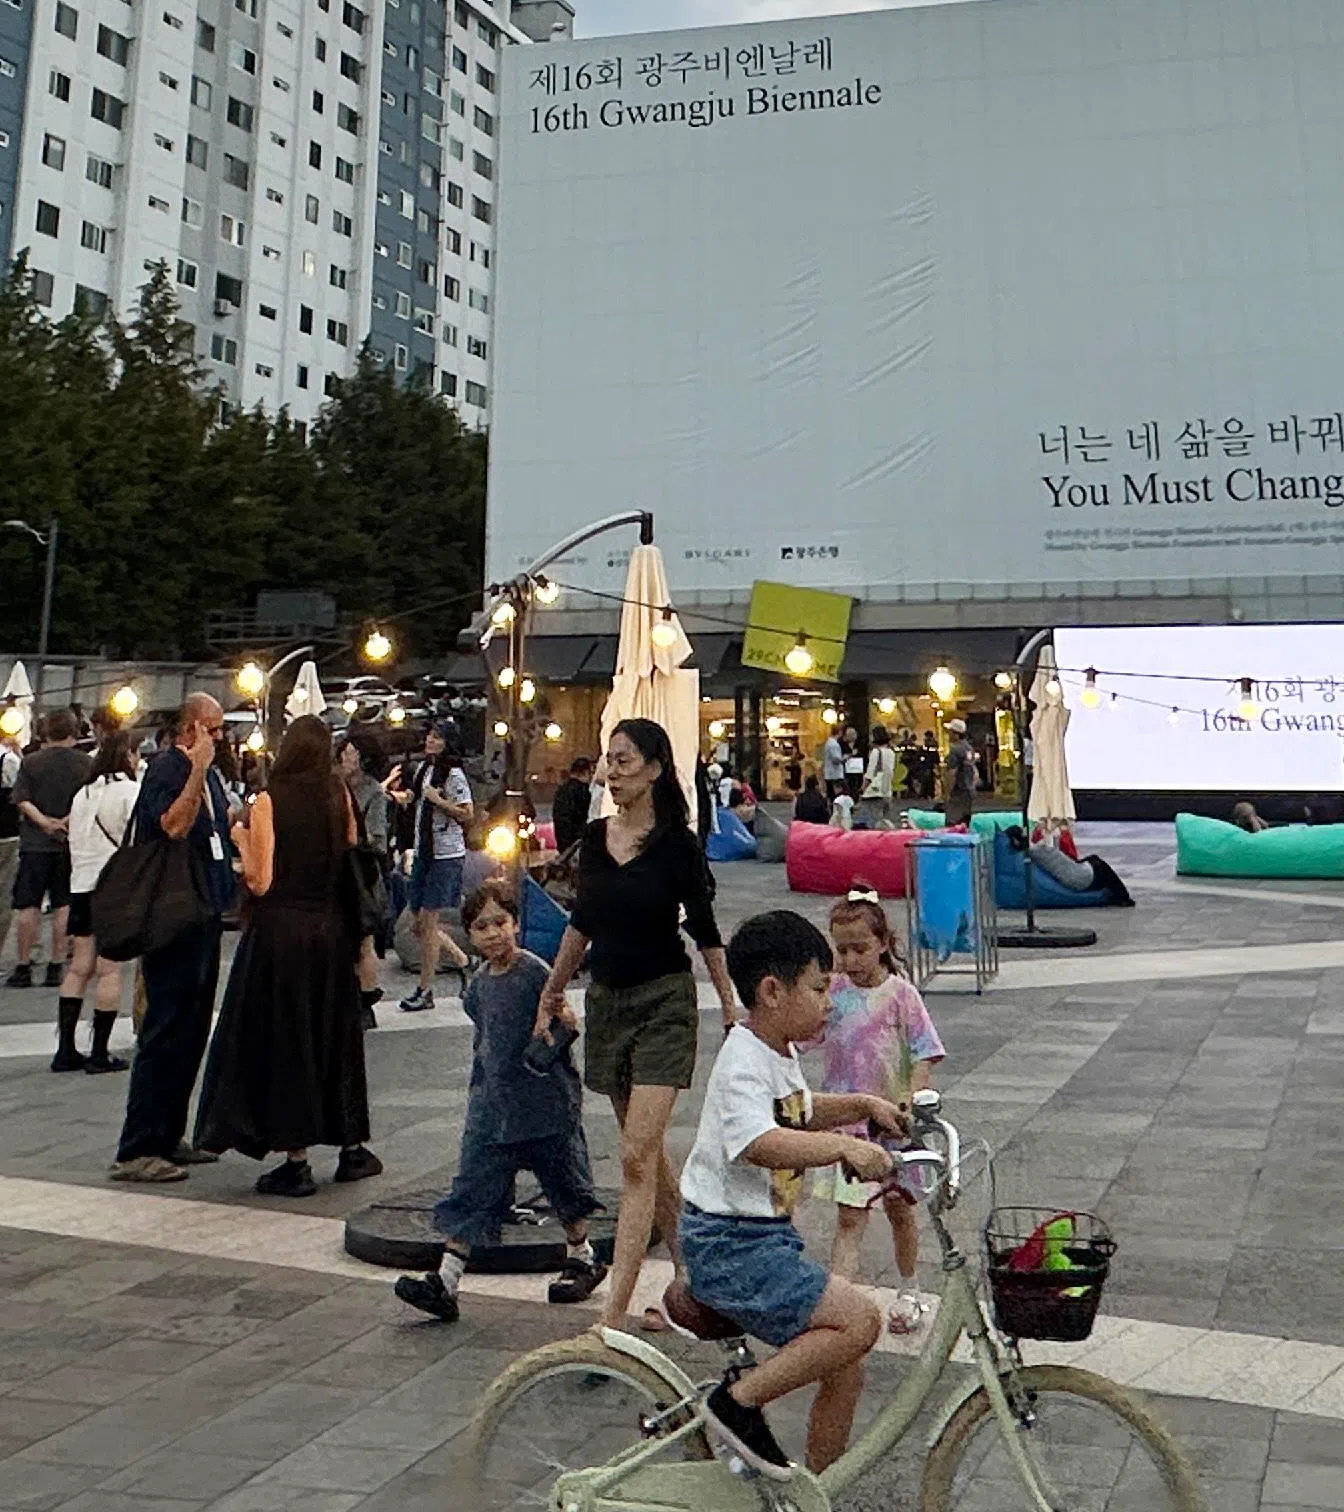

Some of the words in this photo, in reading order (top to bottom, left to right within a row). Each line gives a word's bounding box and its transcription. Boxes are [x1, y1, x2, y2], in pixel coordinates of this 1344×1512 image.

[529, 57, 623, 96] 제16회
[634, 37, 834, 88] 광주비엔날레
[530, 102, 589, 133] 16th
[599, 90, 736, 129] Gwangju
[746, 78, 882, 116] Biennale
[1038, 425, 1113, 464] 너는
[1127, 421, 1161, 461] 네
[1174, 417, 1255, 459] 삶을
[1043, 474, 1110, 509] You
[1122, 470, 1215, 506] Must
